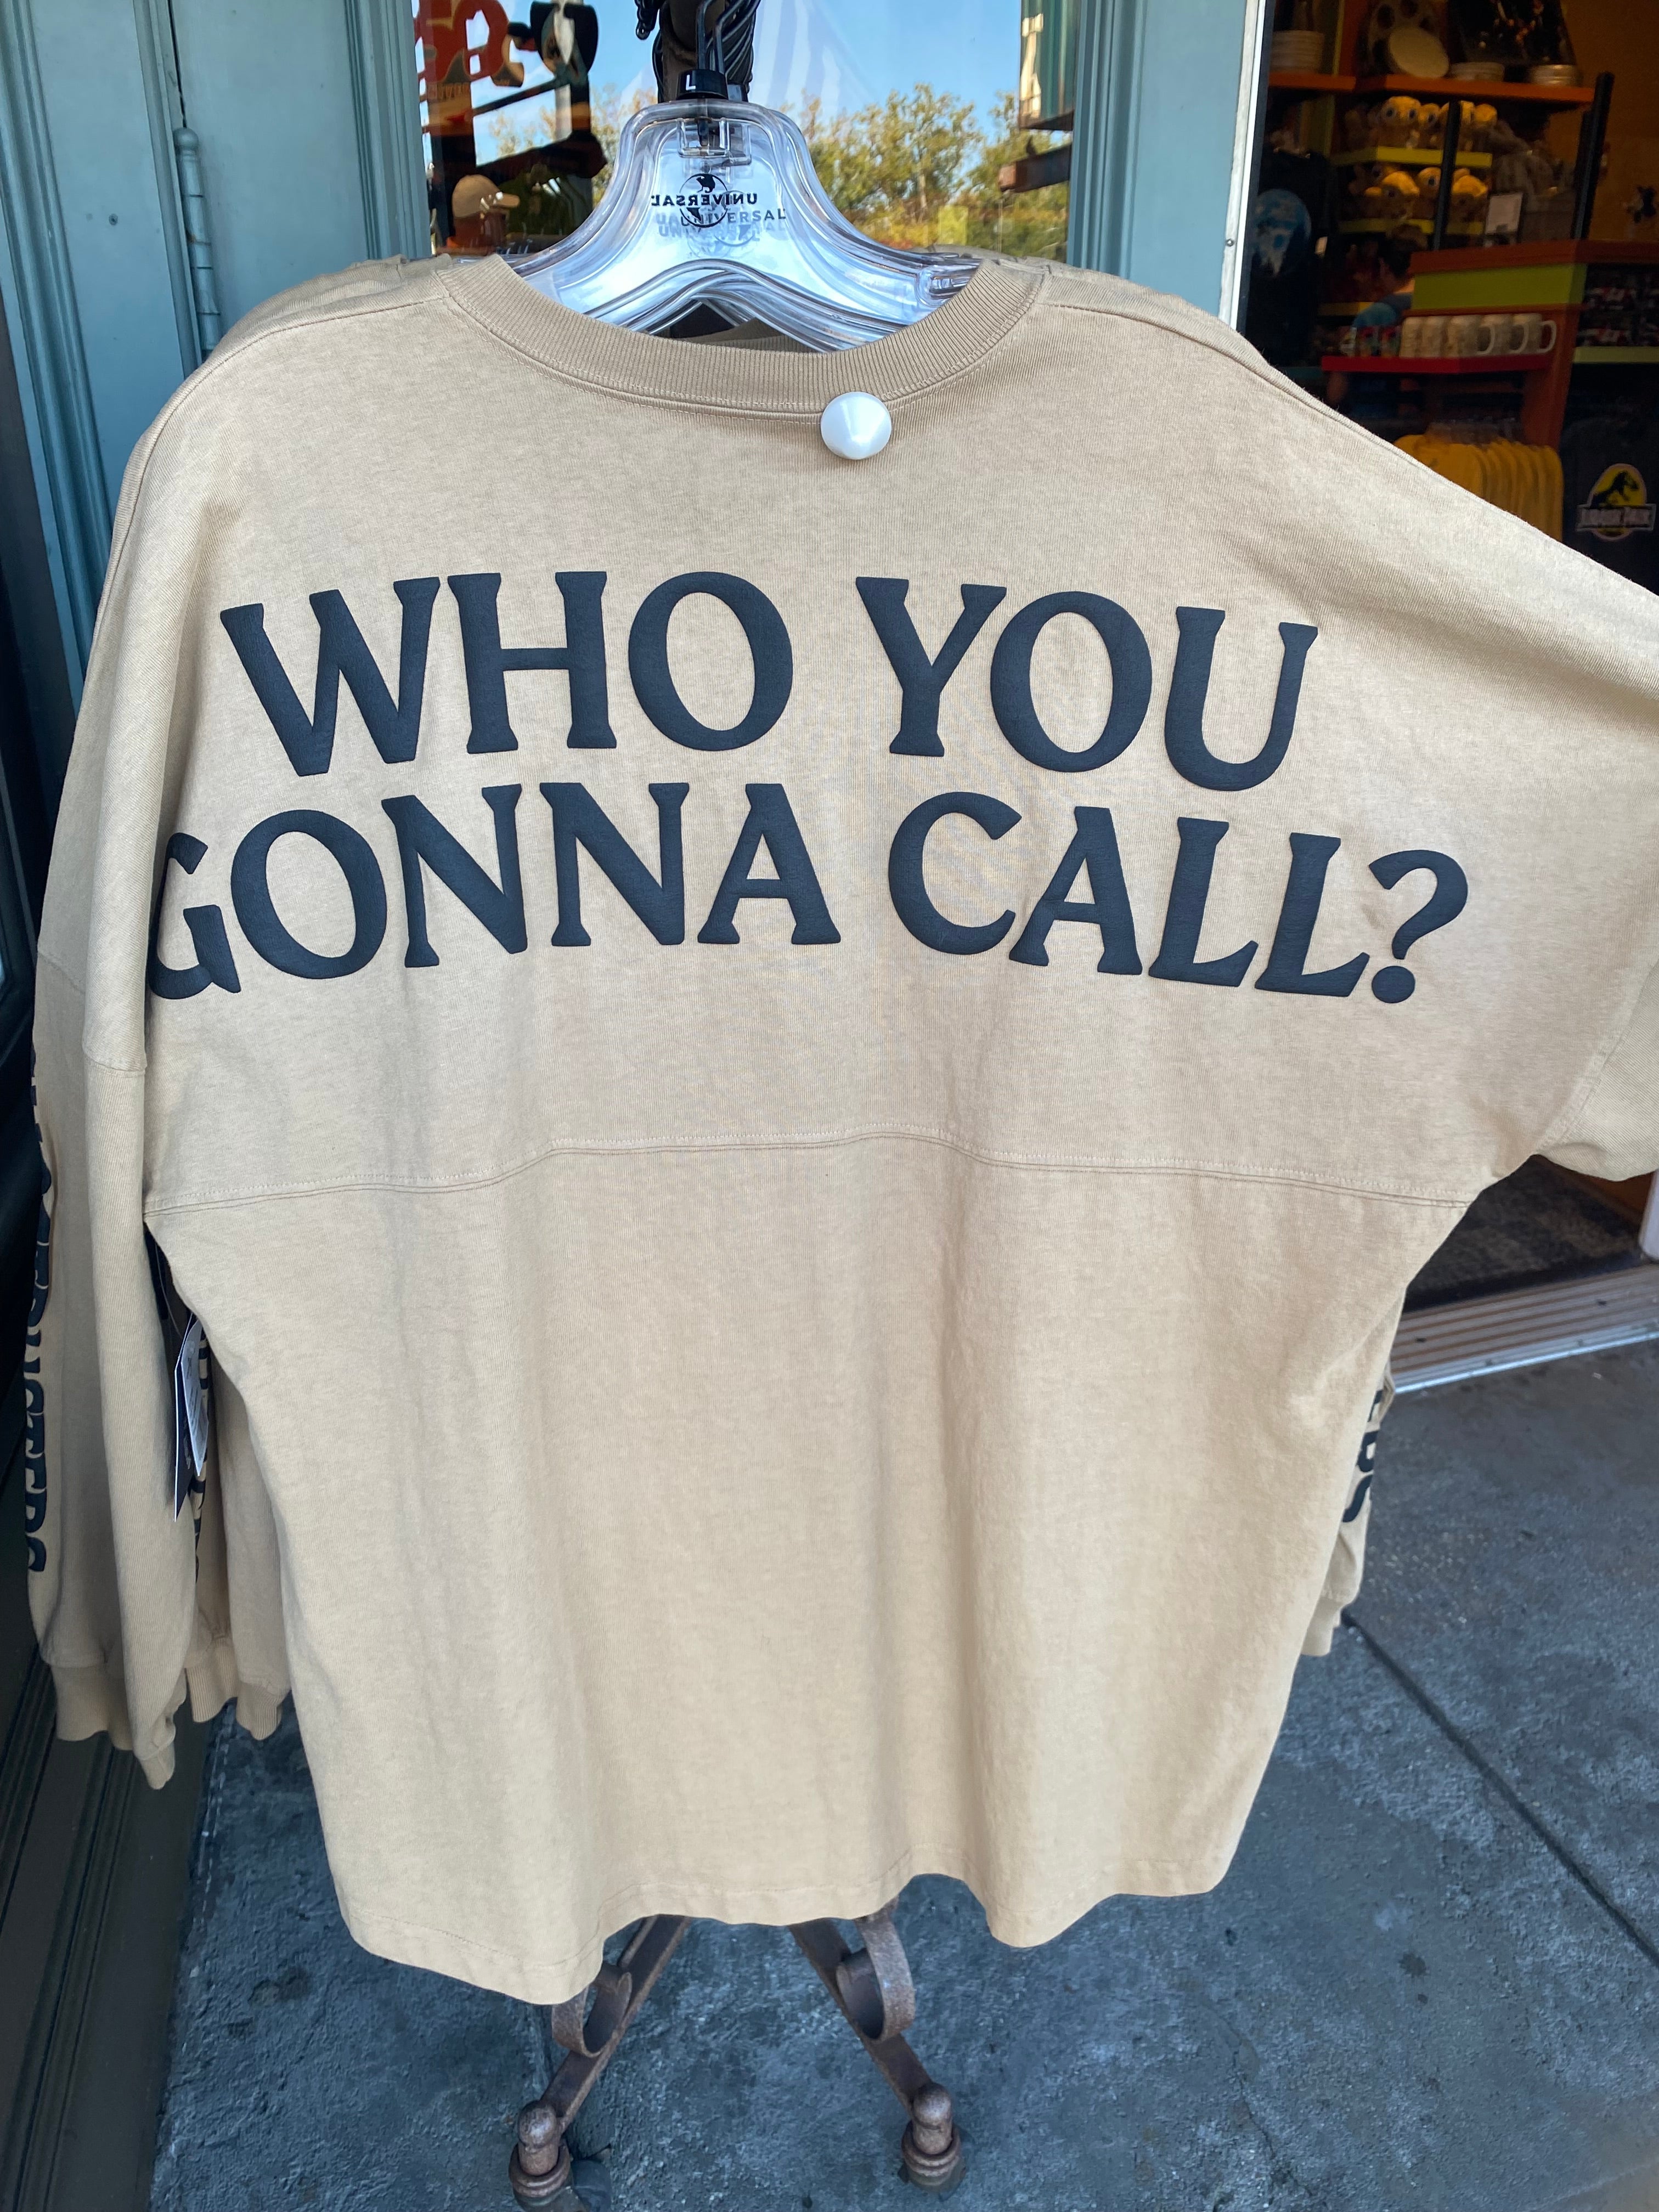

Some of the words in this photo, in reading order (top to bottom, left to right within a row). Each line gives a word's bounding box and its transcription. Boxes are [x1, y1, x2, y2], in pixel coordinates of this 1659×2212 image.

[686, 74, 696, 91] L
[219, 571, 794, 777] WHO
[855, 575, 1319, 792] YOU
[146, 782, 842, 1000] GONNA
[888, 791, 1469, 1004] CALL?
